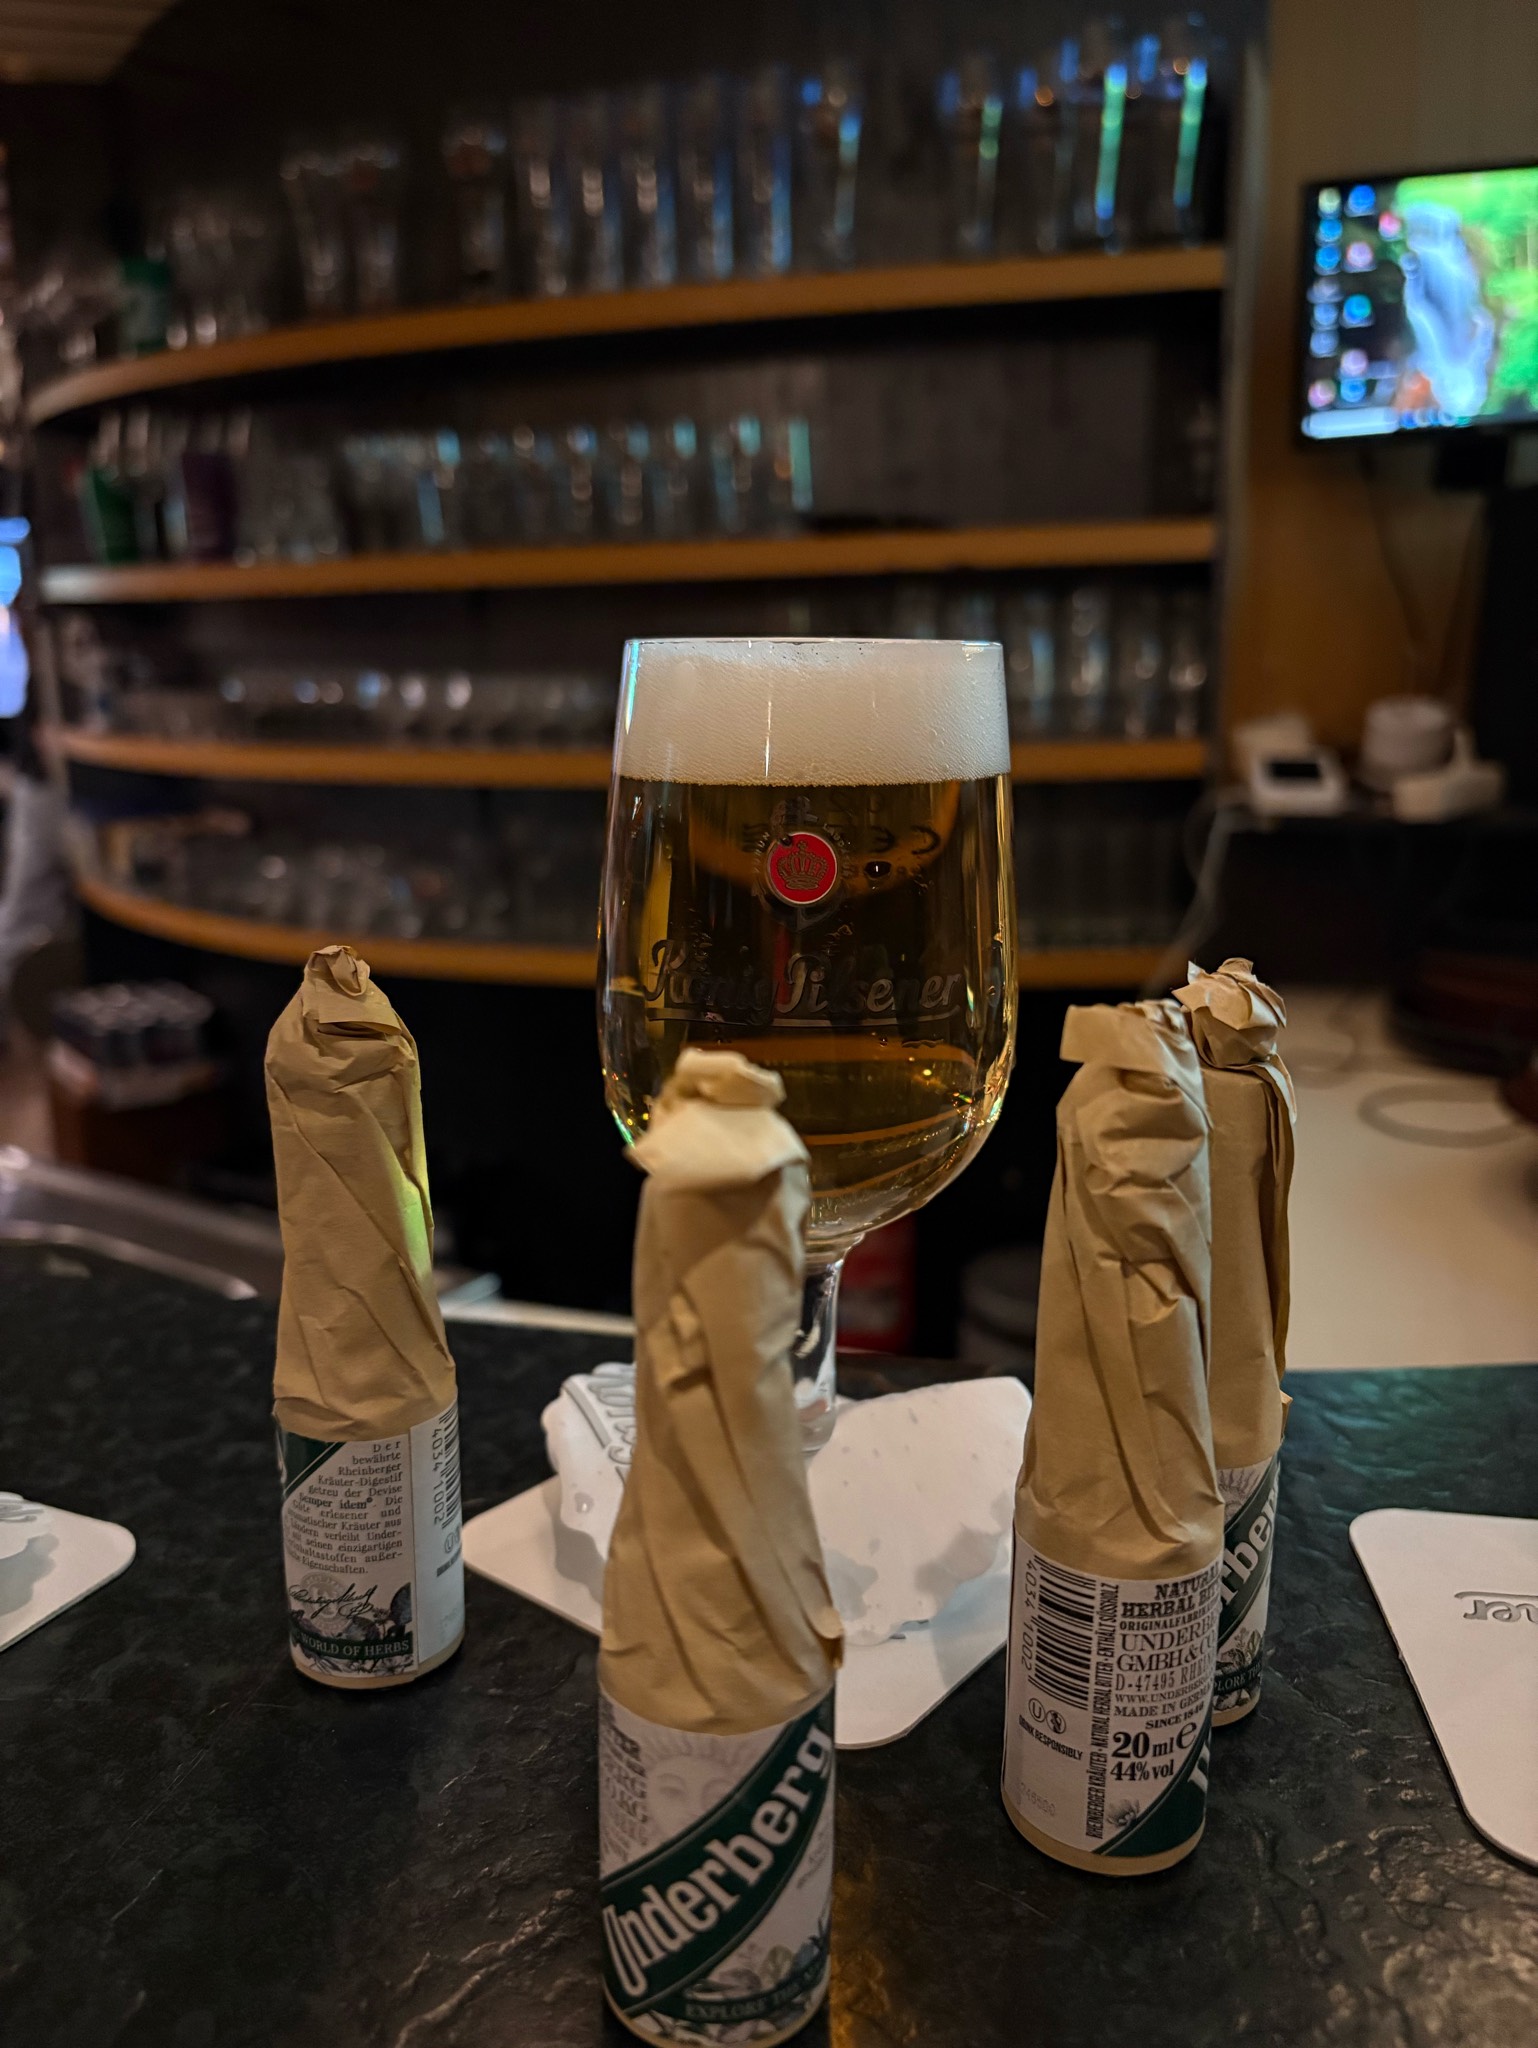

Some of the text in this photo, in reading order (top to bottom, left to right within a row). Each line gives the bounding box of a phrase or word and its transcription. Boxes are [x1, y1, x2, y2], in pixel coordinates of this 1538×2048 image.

[338, 1463, 402, 1476] Rheinberger
[352, 1452, 402, 1465] bewährte
[318, 1471, 403, 1487] Kräuter-Digestif
[431, 1428, 444, 1525] 4034 1002
[308, 1484, 403, 1498] getreu der Devise
[385, 1495, 403, 1506] Die
[380, 1505, 402, 1517] und
[341, 1518, 380, 1531] Kräuter
[384, 1518, 402, 1528] aus
[306, 1538, 333, 1551] seinen
[338, 1539, 403, 1555] einzigartigen
[1021, 1559, 1038, 1671] 4034 1002
[1121, 1595, 1196, 1619] HERBAL
[300, 1633, 339, 1655] WORLD
[343, 1644, 361, 1657] OF
[364, 1639, 410, 1657] HERBS
[1095, 1622, 1116, 1658] ENTHÄLT
[1116, 1649, 1183, 1672] GMBH
[1184, 1644, 1199, 1663] &
[1095, 1661, 1113, 1688] BITTER
[1093, 1689, 1112, 1716] HERBAL
[1113, 1704, 1157, 1718] MADE
[1162, 1702, 1176, 1715] IN
[1090, 1716, 1110, 1748] NATURAL
[1145, 1714, 1182, 1730] SINCE
[1034, 1730, 1083, 1760] RESPONSIBLY
[1111, 1731, 1150, 1759] 20
[1152, 1737, 1175, 1758] ml
[1086, 1751, 1107, 1787] KRÄUTER
[1110, 1759, 1175, 1782] 44% vol
[1085, 1787, 1105, 1840] RHEINBERGER
[603, 1723, 833, 1997] Underberg
